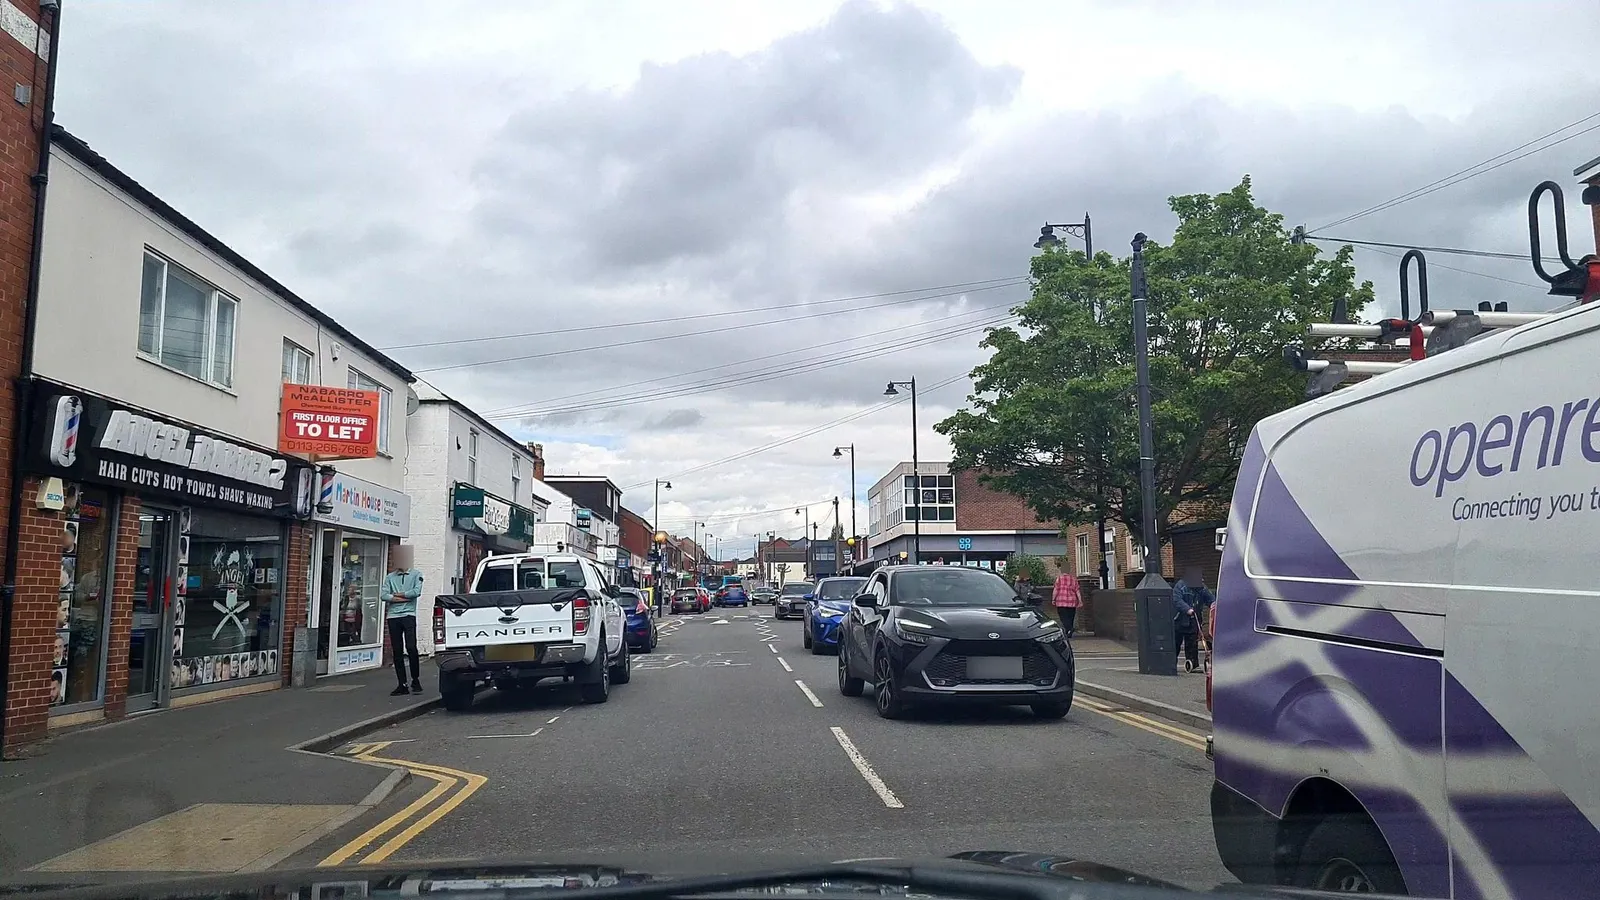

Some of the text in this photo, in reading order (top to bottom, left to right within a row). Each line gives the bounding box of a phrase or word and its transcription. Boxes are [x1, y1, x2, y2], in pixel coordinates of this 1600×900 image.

[291, 393, 371, 407] McALLISTER
[300, 386, 364, 399] NABARRO
[293, 412, 368, 426] FIRST FLOOR OFFICE
[295, 422, 364, 440] TO LET
[100, 410, 192, 468] ANGEL
[189, 435, 274, 488] BARBER
[287, 440, 369, 455] 0113-266-7666
[98, 460, 273, 509] HAIR CUTS HOT TOWEL SHAVE WAXING
[336, 482, 381, 512] Martin House
[455, 499, 481, 507] Budgens
[1452, 486, 1600, 521] Connecting you t
[456, 626, 562, 639] RANGER
